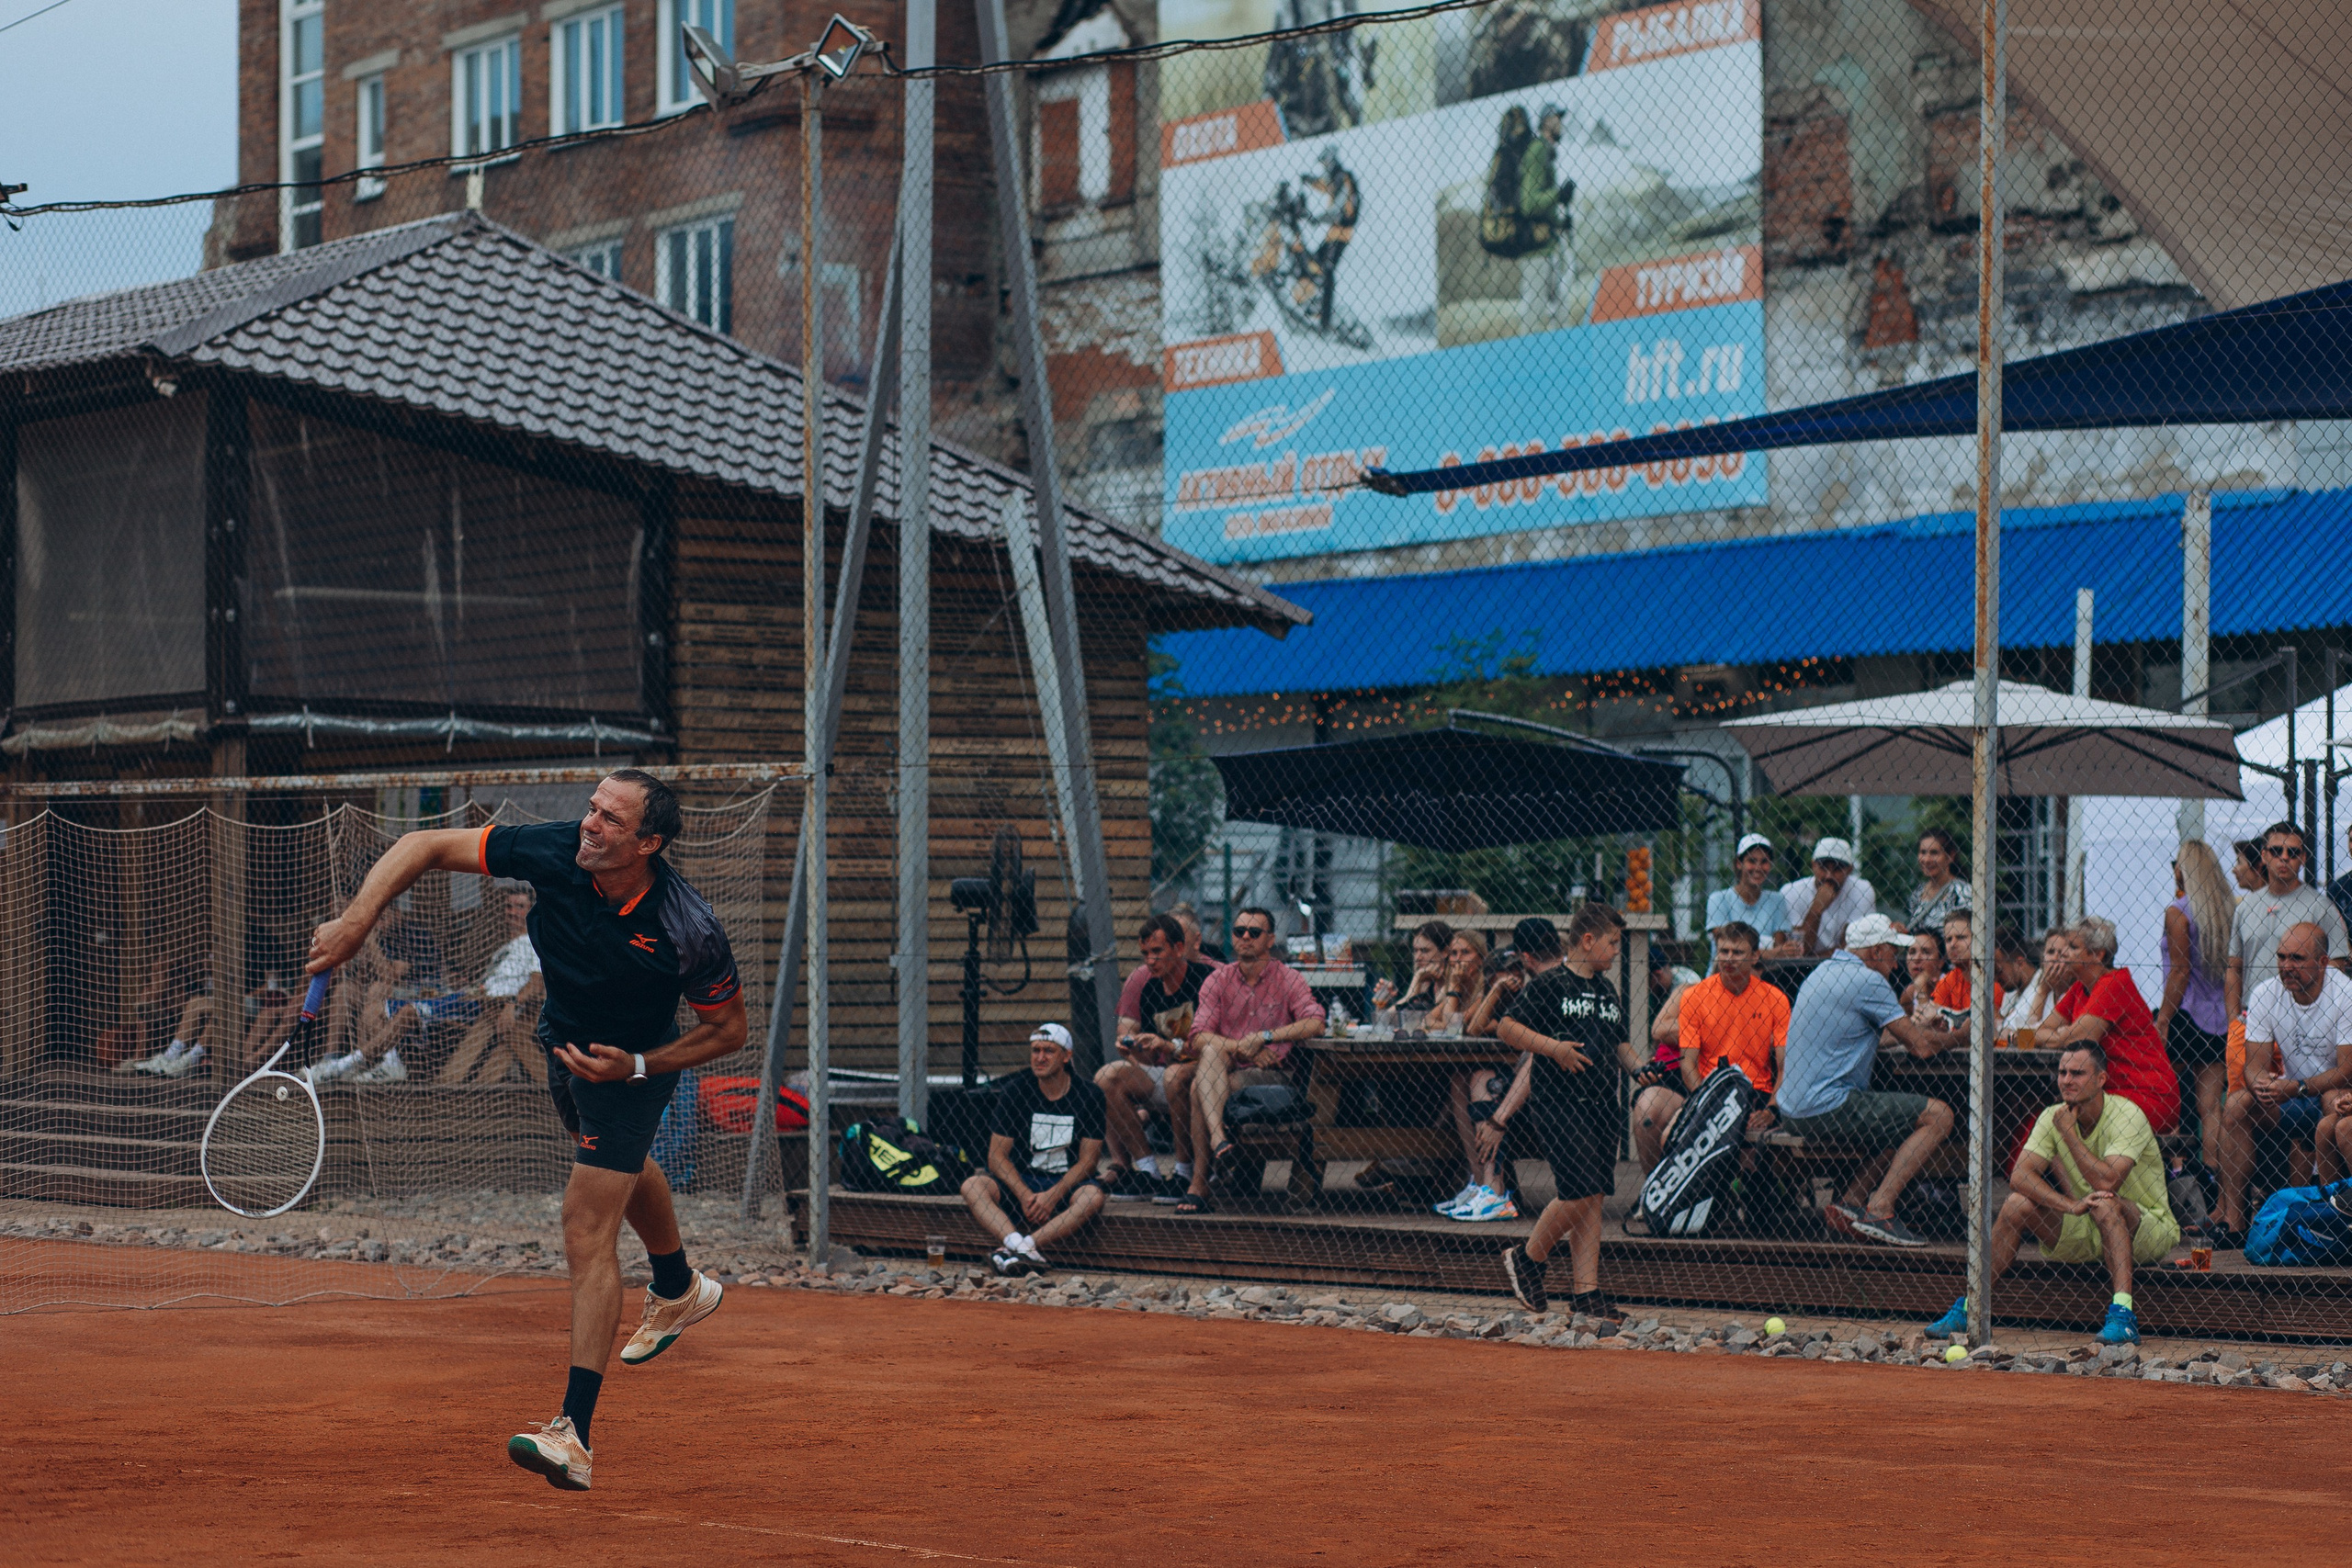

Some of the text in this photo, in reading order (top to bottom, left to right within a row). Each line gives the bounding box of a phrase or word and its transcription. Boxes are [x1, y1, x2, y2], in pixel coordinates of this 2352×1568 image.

[1611, 0, 1745, 62] РЫБАЛКА
[1634, 254, 1746, 310] ТУРИЗМ
[1645, 1088, 1743, 1213] Babolat
